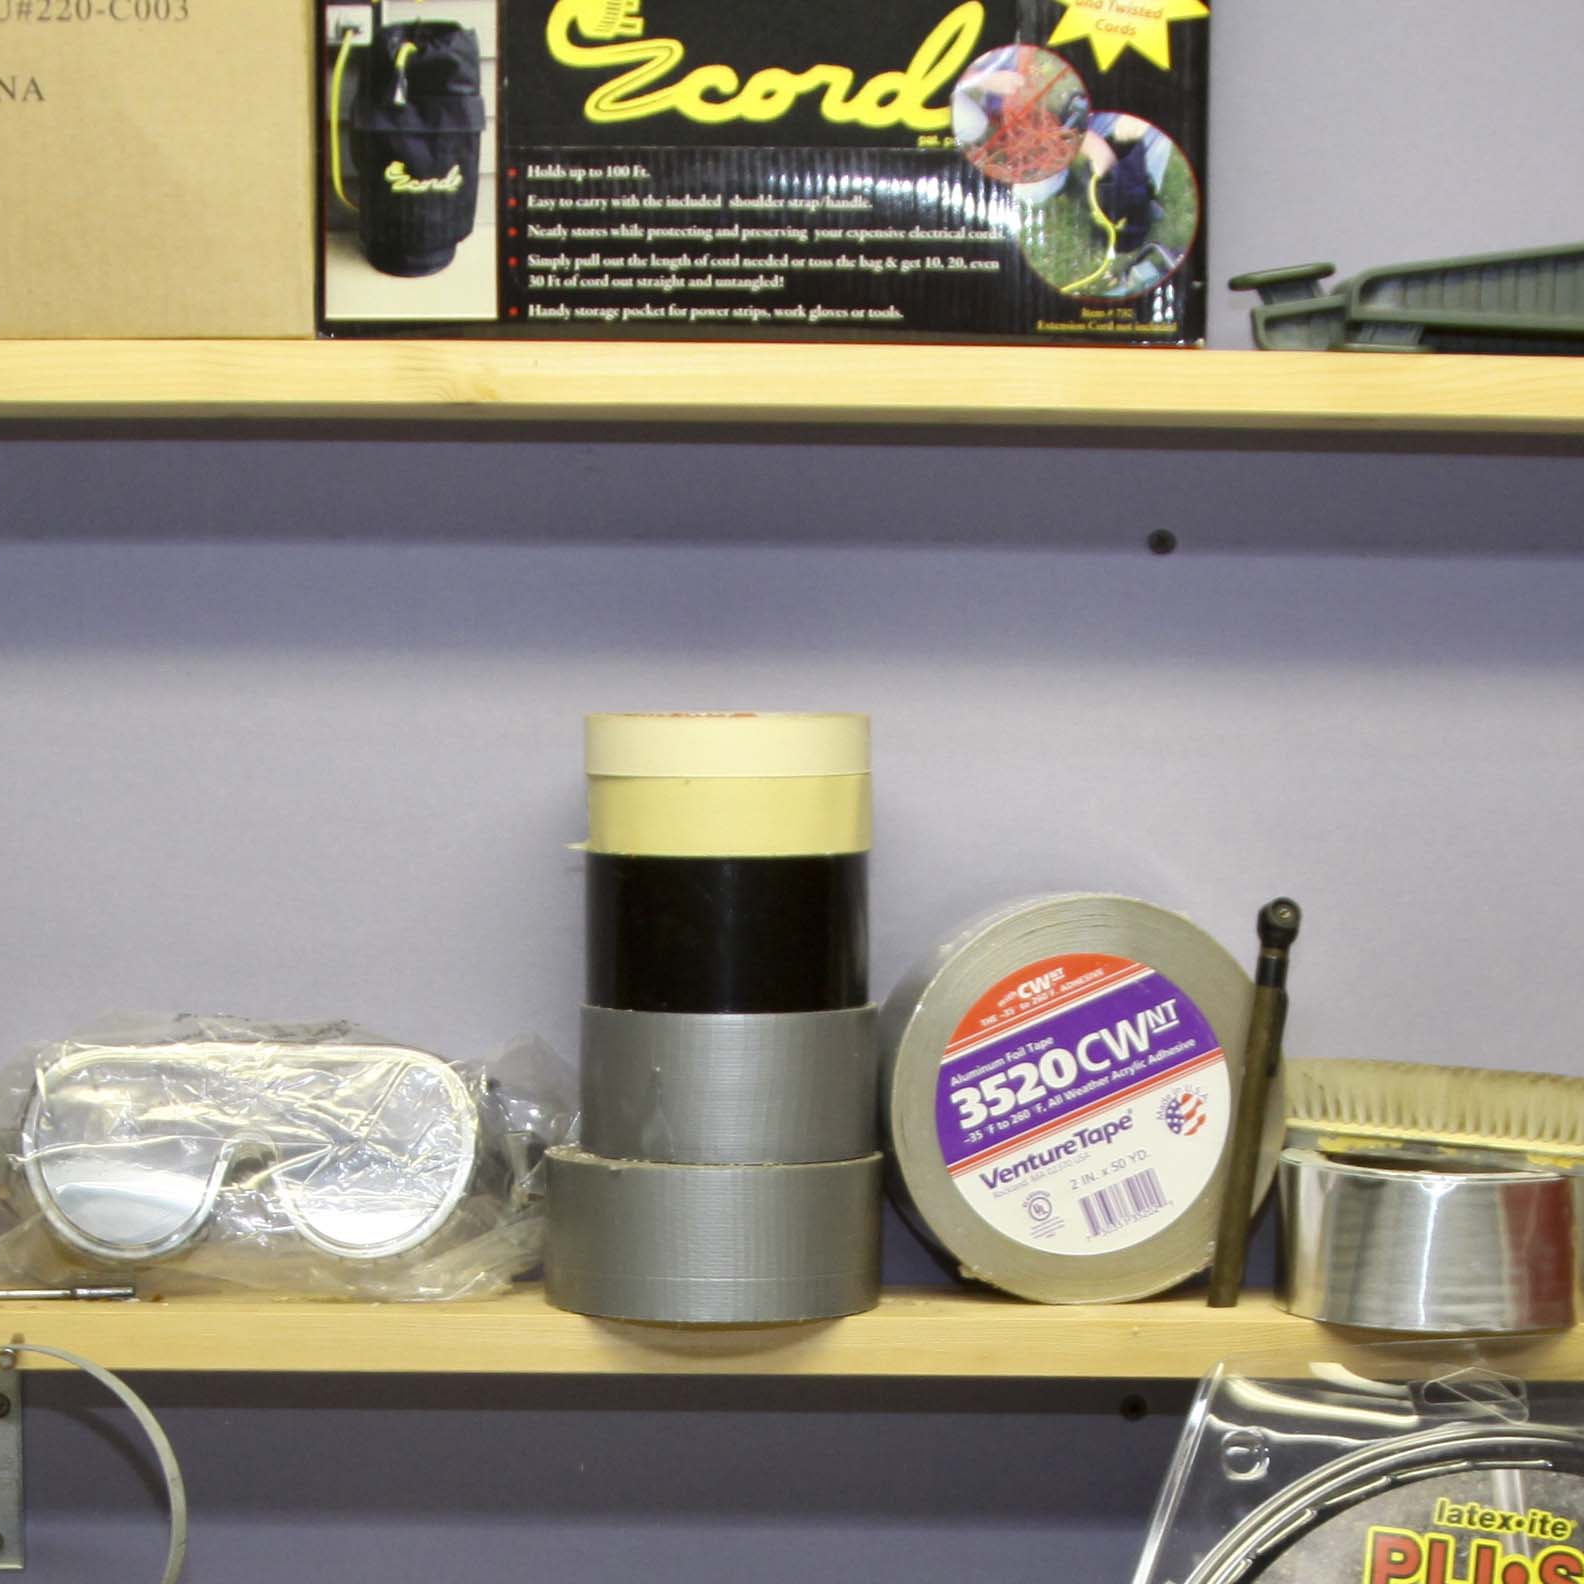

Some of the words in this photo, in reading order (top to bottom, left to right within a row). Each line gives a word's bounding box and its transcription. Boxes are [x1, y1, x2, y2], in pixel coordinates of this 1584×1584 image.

[1096, 19, 1136, 36] Cords
[528, 164, 567, 179] Holds
[569, 167, 586, 183] up
[589, 167, 603, 178] to
[606, 165, 630, 178] 100
[632, 165, 651, 178] Ft.
[950, 1057, 1007, 1087] Aluminum
[1006, 1043, 1027, 1062] Foil
[1028, 1036, 1054, 1056] Tape
[950, 1048, 1077, 1129] 3520
[1048, 1095, 1063, 1108] All
[1064, 1076, 1110, 1103] Weather
[1111, 1060, 1147, 1082] Acrylic
[1147, 1039, 1196, 1064] Adhesive
[978, 1114, 1134, 1189] VentureTape
